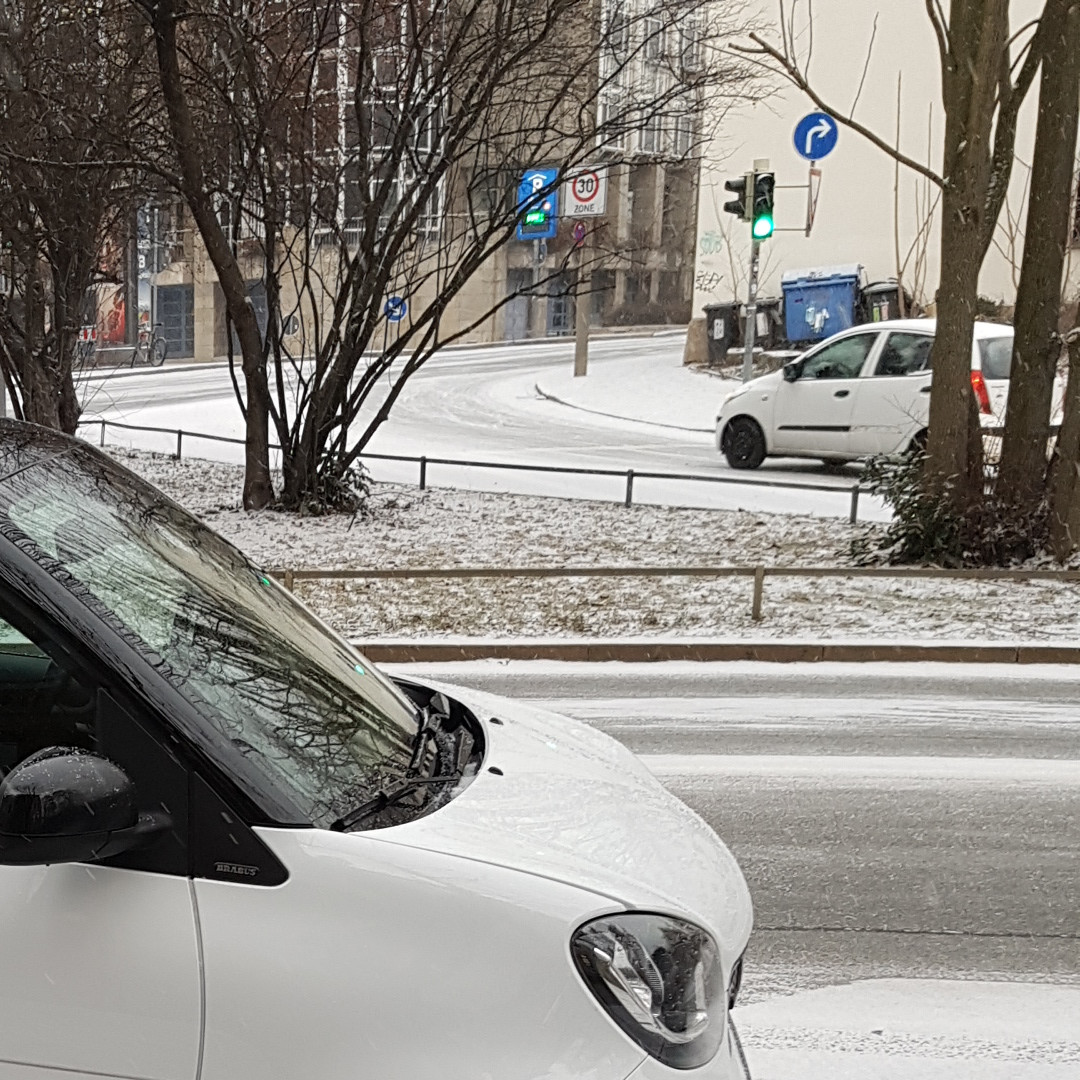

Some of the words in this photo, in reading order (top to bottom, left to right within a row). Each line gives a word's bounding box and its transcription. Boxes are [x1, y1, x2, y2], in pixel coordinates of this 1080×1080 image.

[577, 178, 594, 193] 30
[573, 204, 595, 213] ZONE
[215, 863, 257, 877] BRABUS
